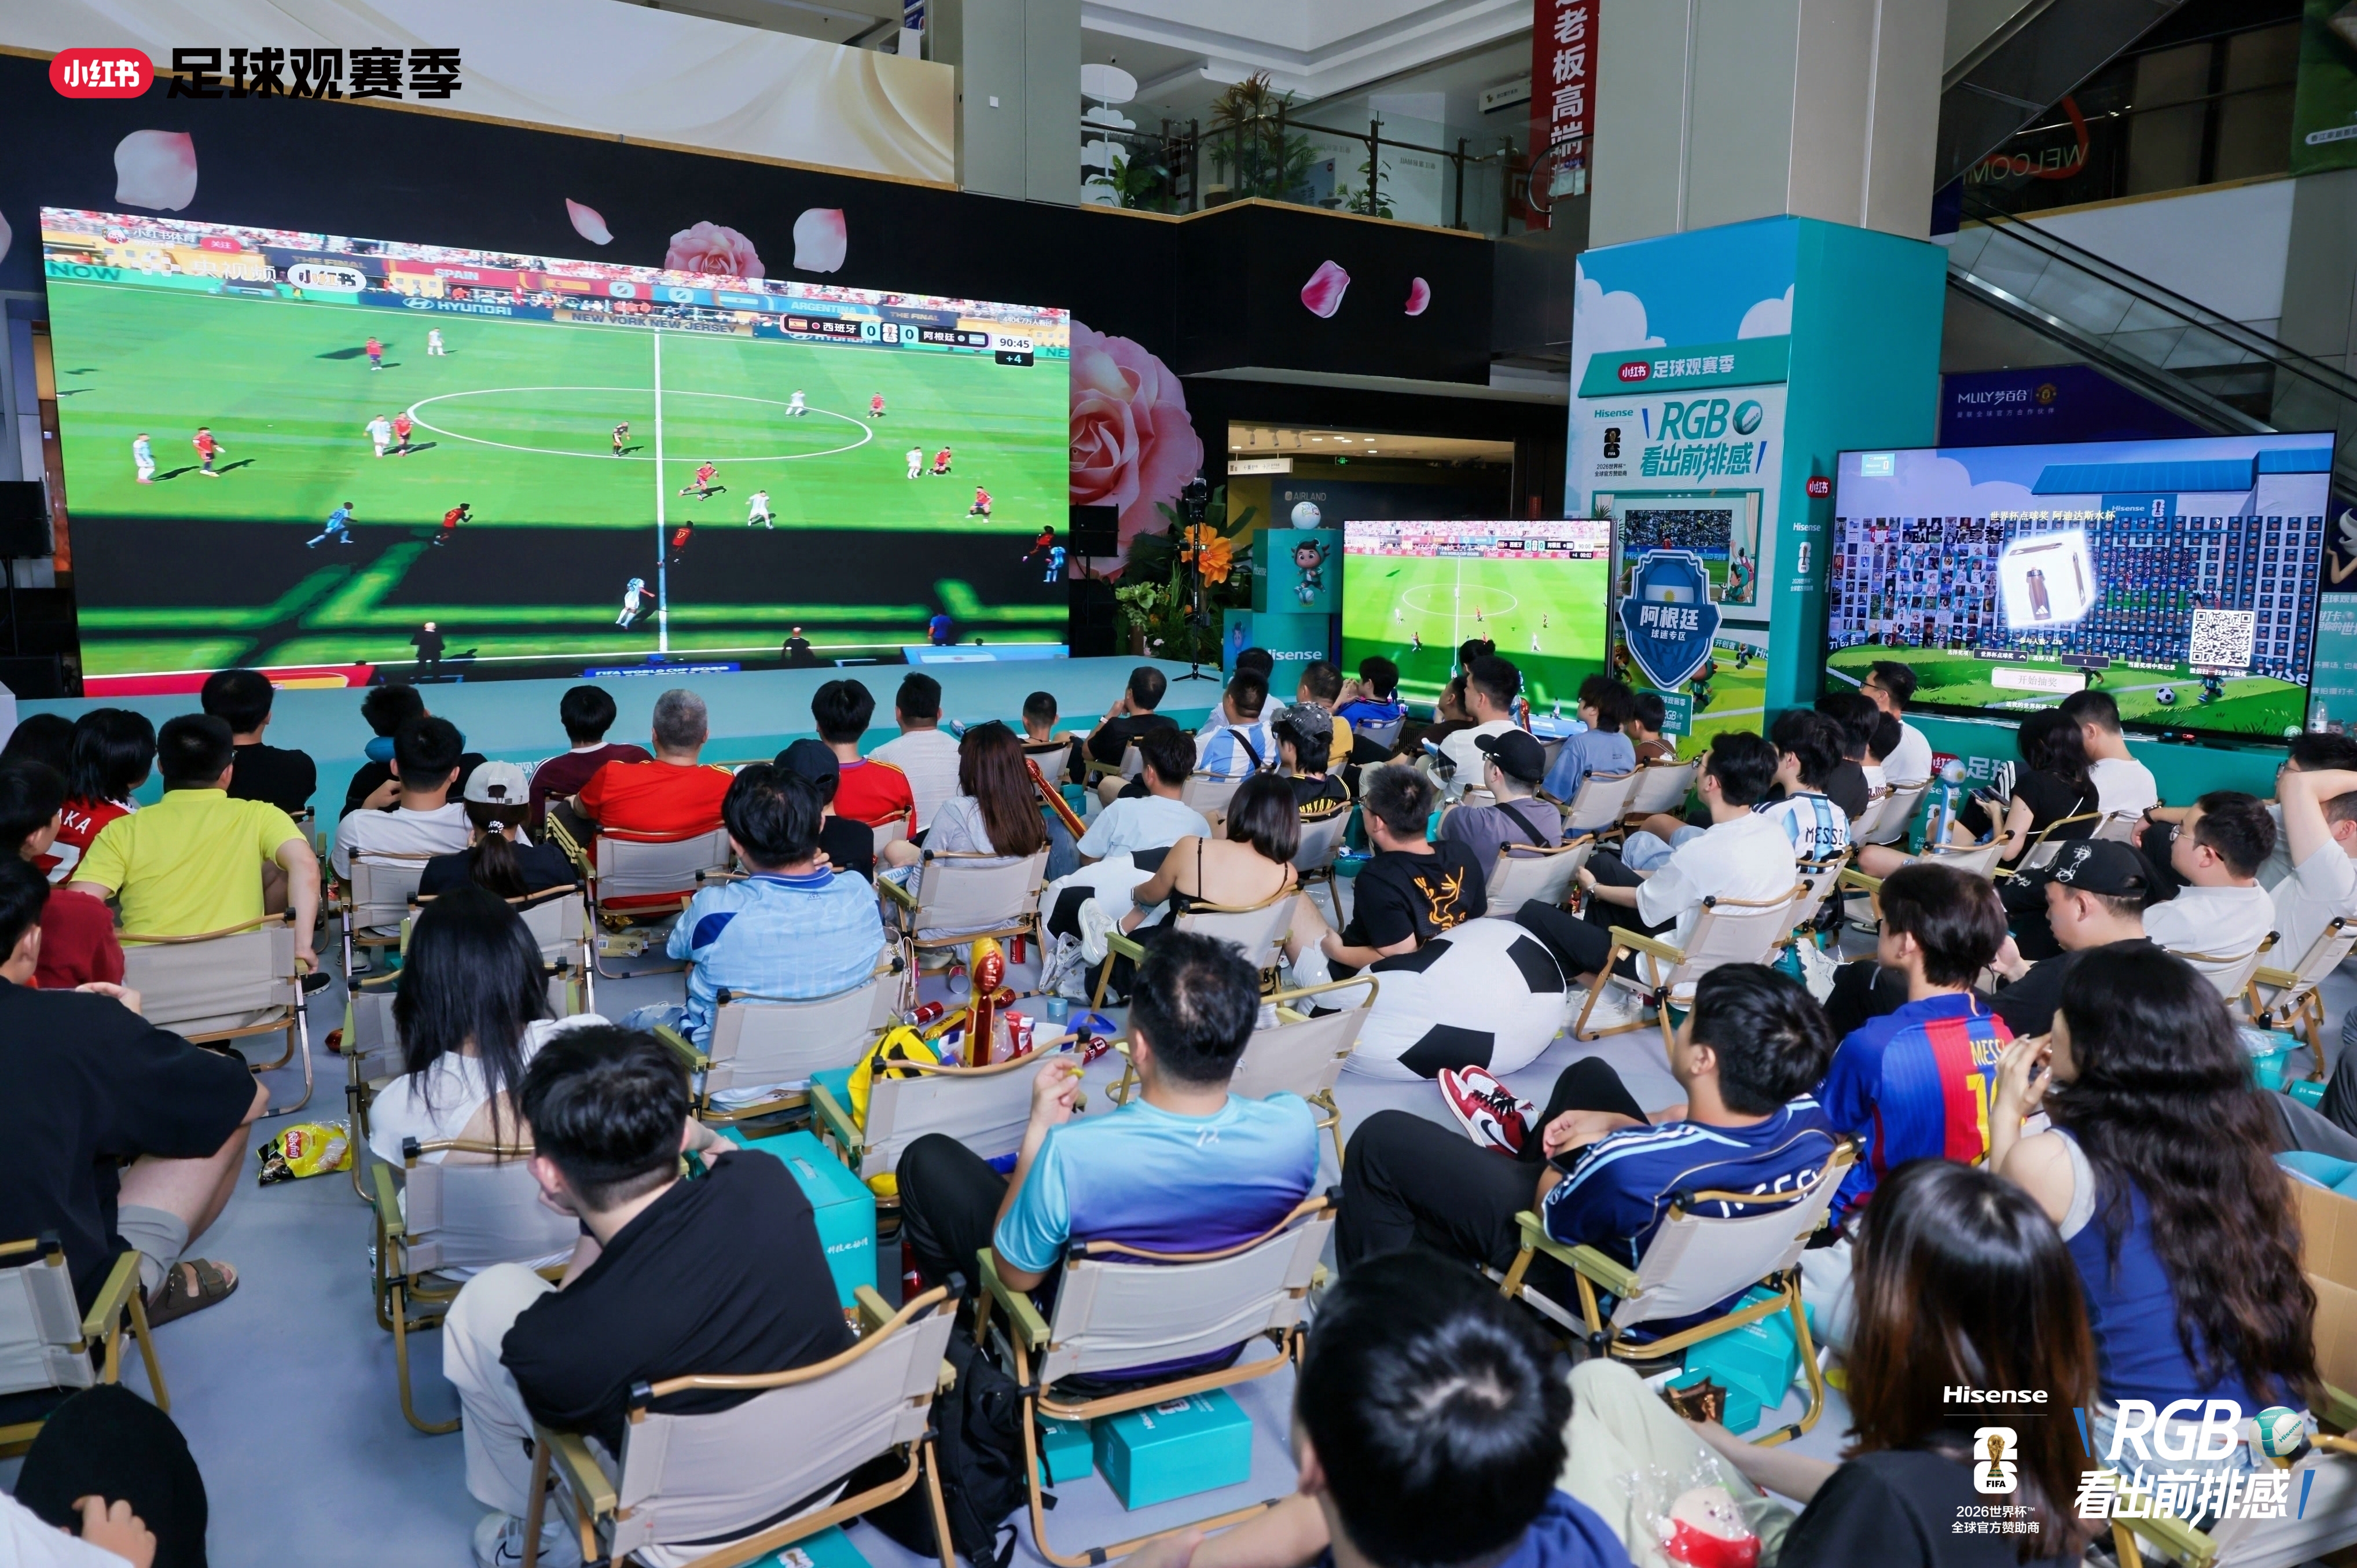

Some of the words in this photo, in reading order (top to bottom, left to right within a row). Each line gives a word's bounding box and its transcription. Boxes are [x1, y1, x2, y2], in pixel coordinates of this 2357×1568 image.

[211, 240, 232, 249] 关注
[292, 256, 322, 265] THE
[324, 259, 368, 269] FINAL
[49, 262, 120, 281] NOW
[193, 260, 277, 283] 央视频
[434, 269, 479, 281] SPAIN
[299, 270, 357, 288] 小红书
[438, 301, 512, 315] HYUNDAI
[791, 301, 857, 314] ARGENTINA
[572, 313, 604, 323] NEW
[608, 316, 647, 327] YORK
[649, 319, 681, 329] NEW
[684, 321, 737, 333] JERSEY
[911, 313, 940, 321] FINAL
[823, 322, 857, 334] 西班牙
[867, 325, 876, 336] 0
[905, 329, 914, 340] 0
[923, 331, 955, 343] 阿根廷
[1000, 338, 1030, 348] 90:45
[1006, 355, 1022, 363] +4
[1622, 366, 1646, 378] 小红书
[1653, 355, 1734, 379] 足球观赛季
[1595, 409, 1633, 418] Hisense
[1656, 398, 1730, 440] RGB
[1640, 442, 1754, 484] 看出前排感
[1809, 480, 1828, 494] 小红书
[1294, 492, 1327, 502] AIRLAND
[1989, 511, 2049, 521] 世界杯点球奖
[2052, 509, 2116, 521] 阿迪达斯水杯
[1793, 522, 1821, 532] Hisense
[1253, 563, 1266, 576] Hisense
[1640, 605, 1699, 630] 阿根廷
[1651, 629, 1686, 641] 球迷专区
[1714, 639, 1736, 651] 开创者
[2128, 662, 2176, 671] 当前奖项中奖记录
[2189, 667, 2247, 678] 微信扫一扫参与抽奖
[2018, 674, 2057, 688] 开始抽奖
[1805, 827, 1843, 846] MESSI
